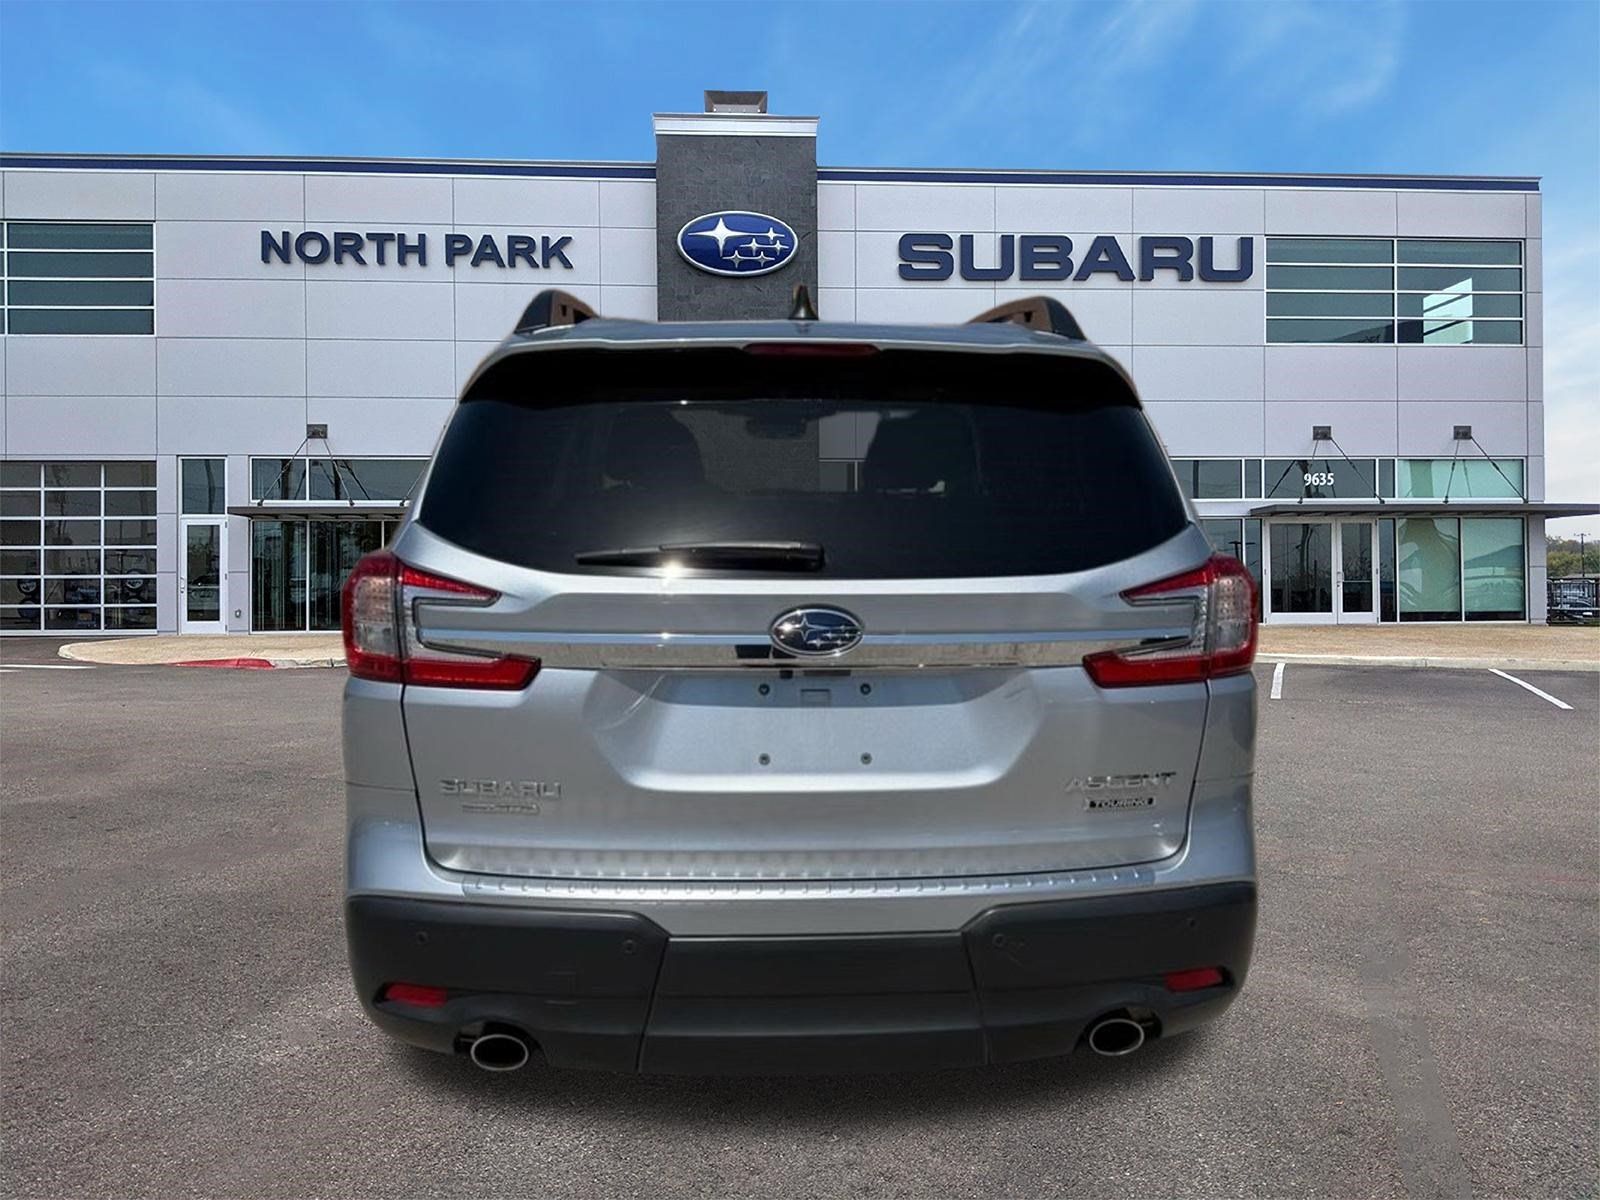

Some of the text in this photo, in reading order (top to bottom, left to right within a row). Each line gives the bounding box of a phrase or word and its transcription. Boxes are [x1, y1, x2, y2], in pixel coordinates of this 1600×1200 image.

[261, 230, 574, 269] NORTH PARK
[898, 233, 1254, 282] SUBARU
[1303, 472, 1335, 486] 9635
[440, 779, 562, 798] SUBARU
[1064, 771, 1177, 792] ASCENT
